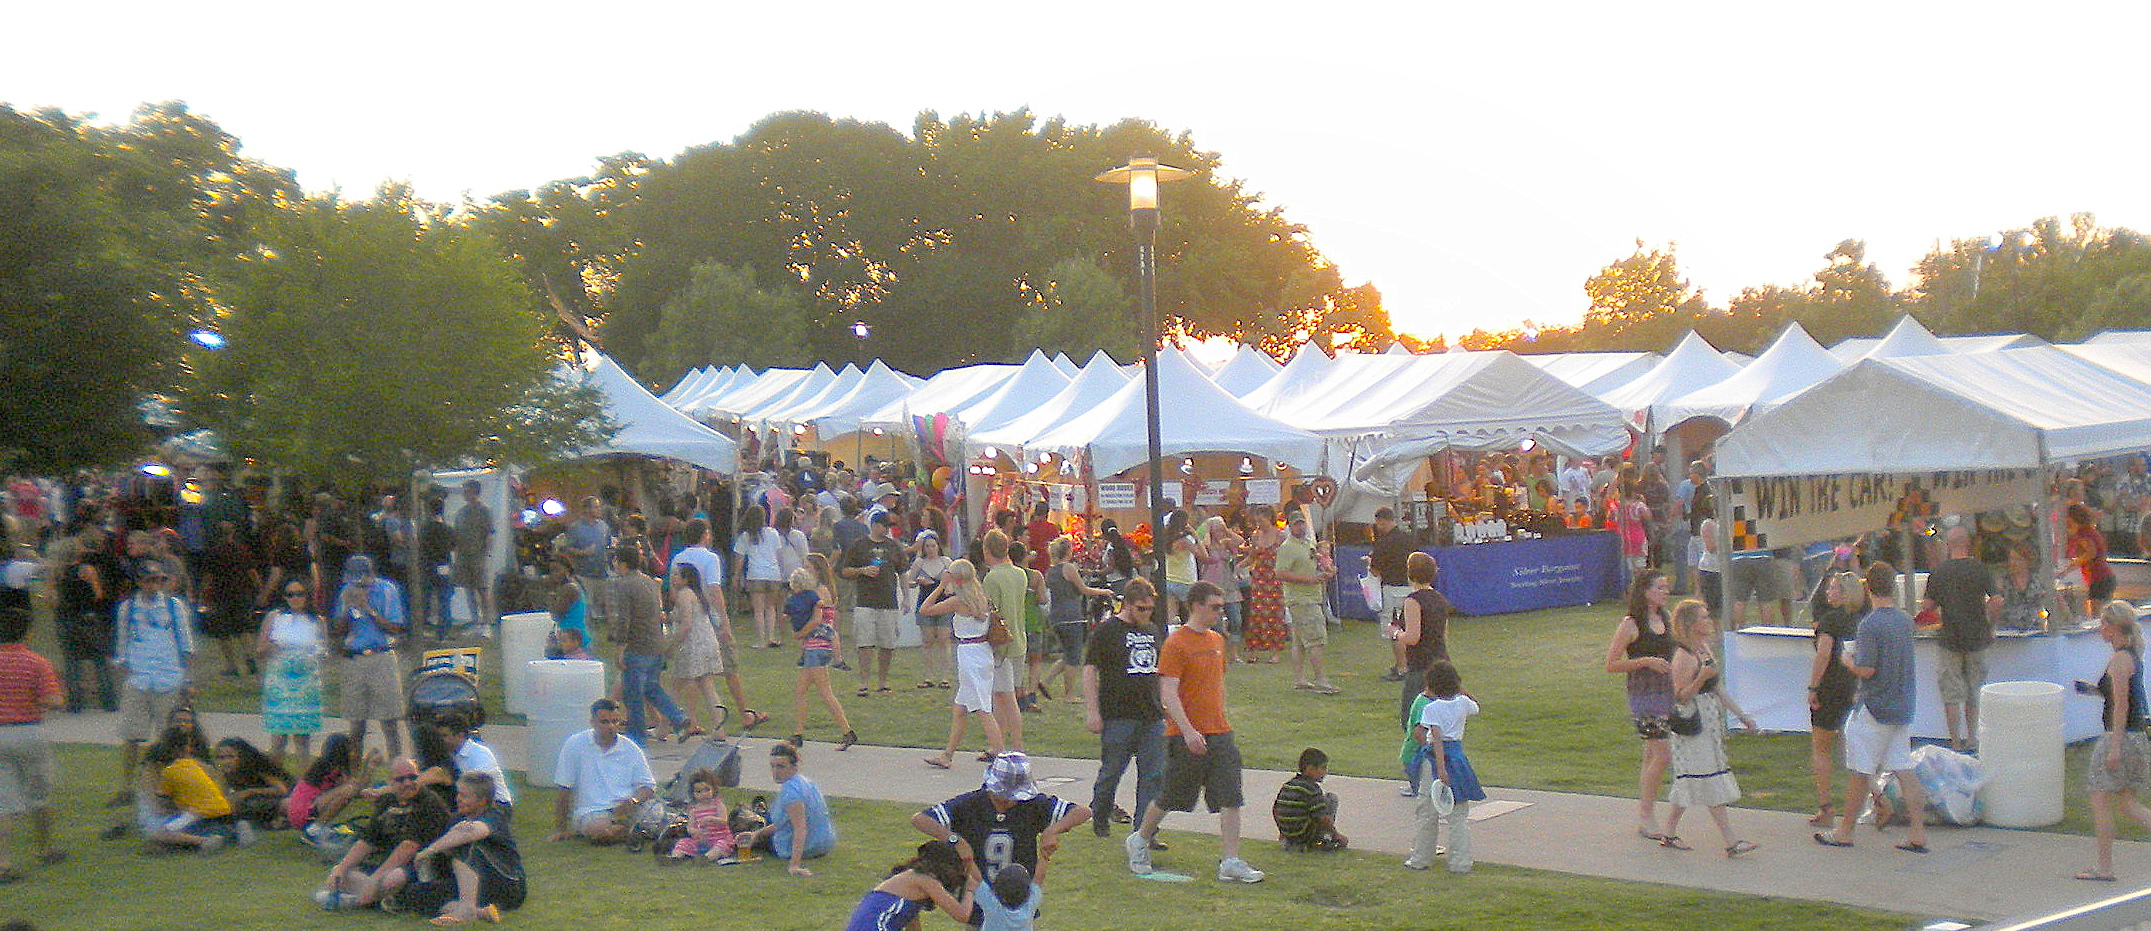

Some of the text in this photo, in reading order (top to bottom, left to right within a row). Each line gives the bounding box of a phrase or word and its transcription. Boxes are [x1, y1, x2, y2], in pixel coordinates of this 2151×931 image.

[1755, 473, 1894, 520] WIN THE CAR!
[984, 833, 1014, 884] 9
